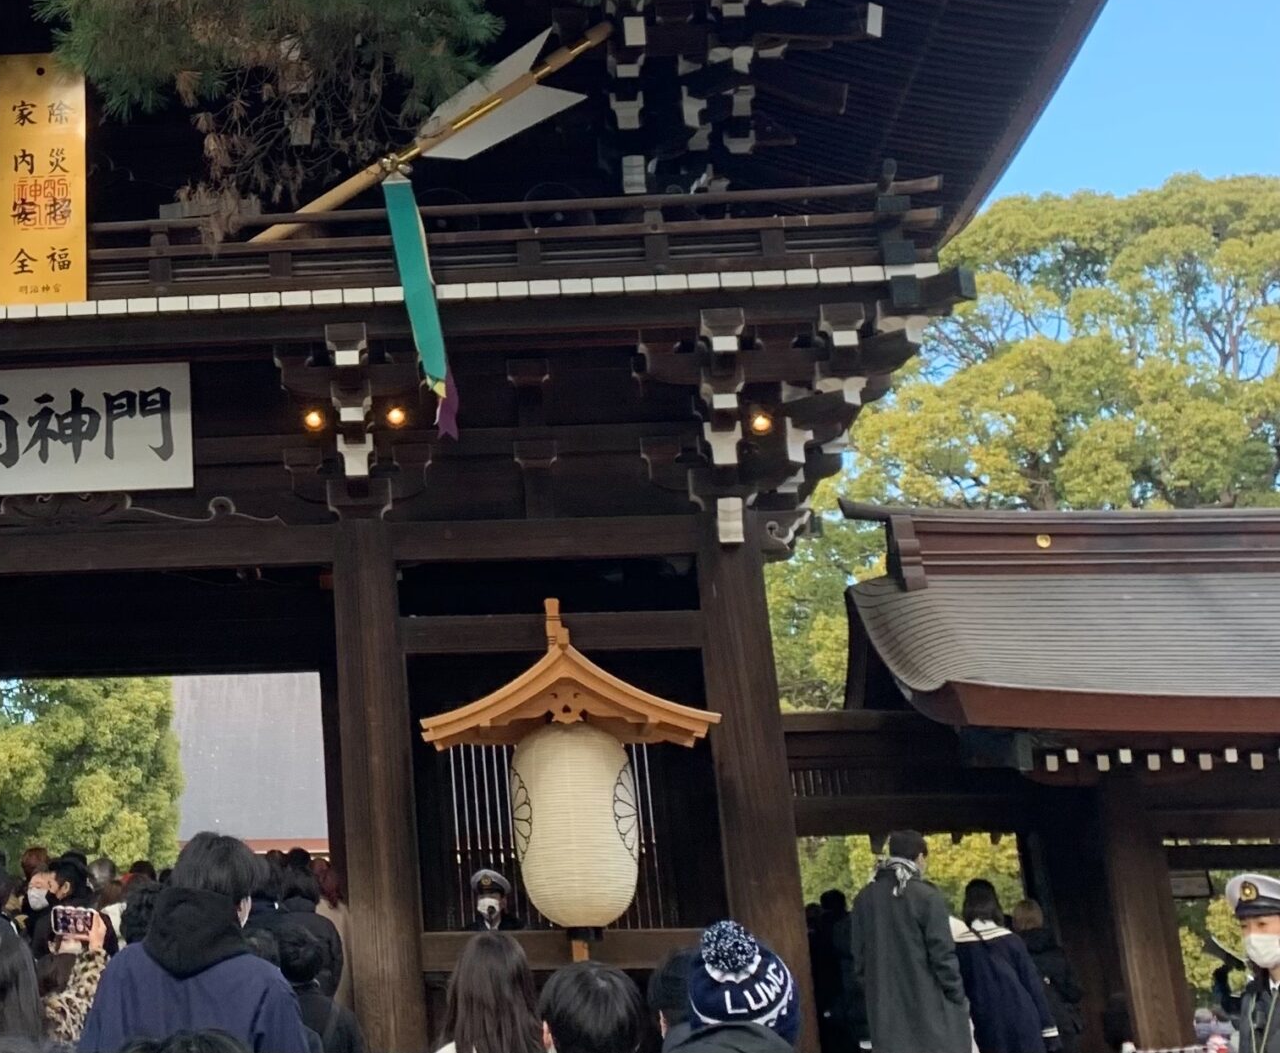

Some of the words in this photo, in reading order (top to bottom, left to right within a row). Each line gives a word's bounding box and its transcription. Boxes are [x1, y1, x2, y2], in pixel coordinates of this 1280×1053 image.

[10, 100, 38, 275] 家内安全
[45, 100, 73, 272] 除災招福
[724, 962, 784, 1014] LUWC
